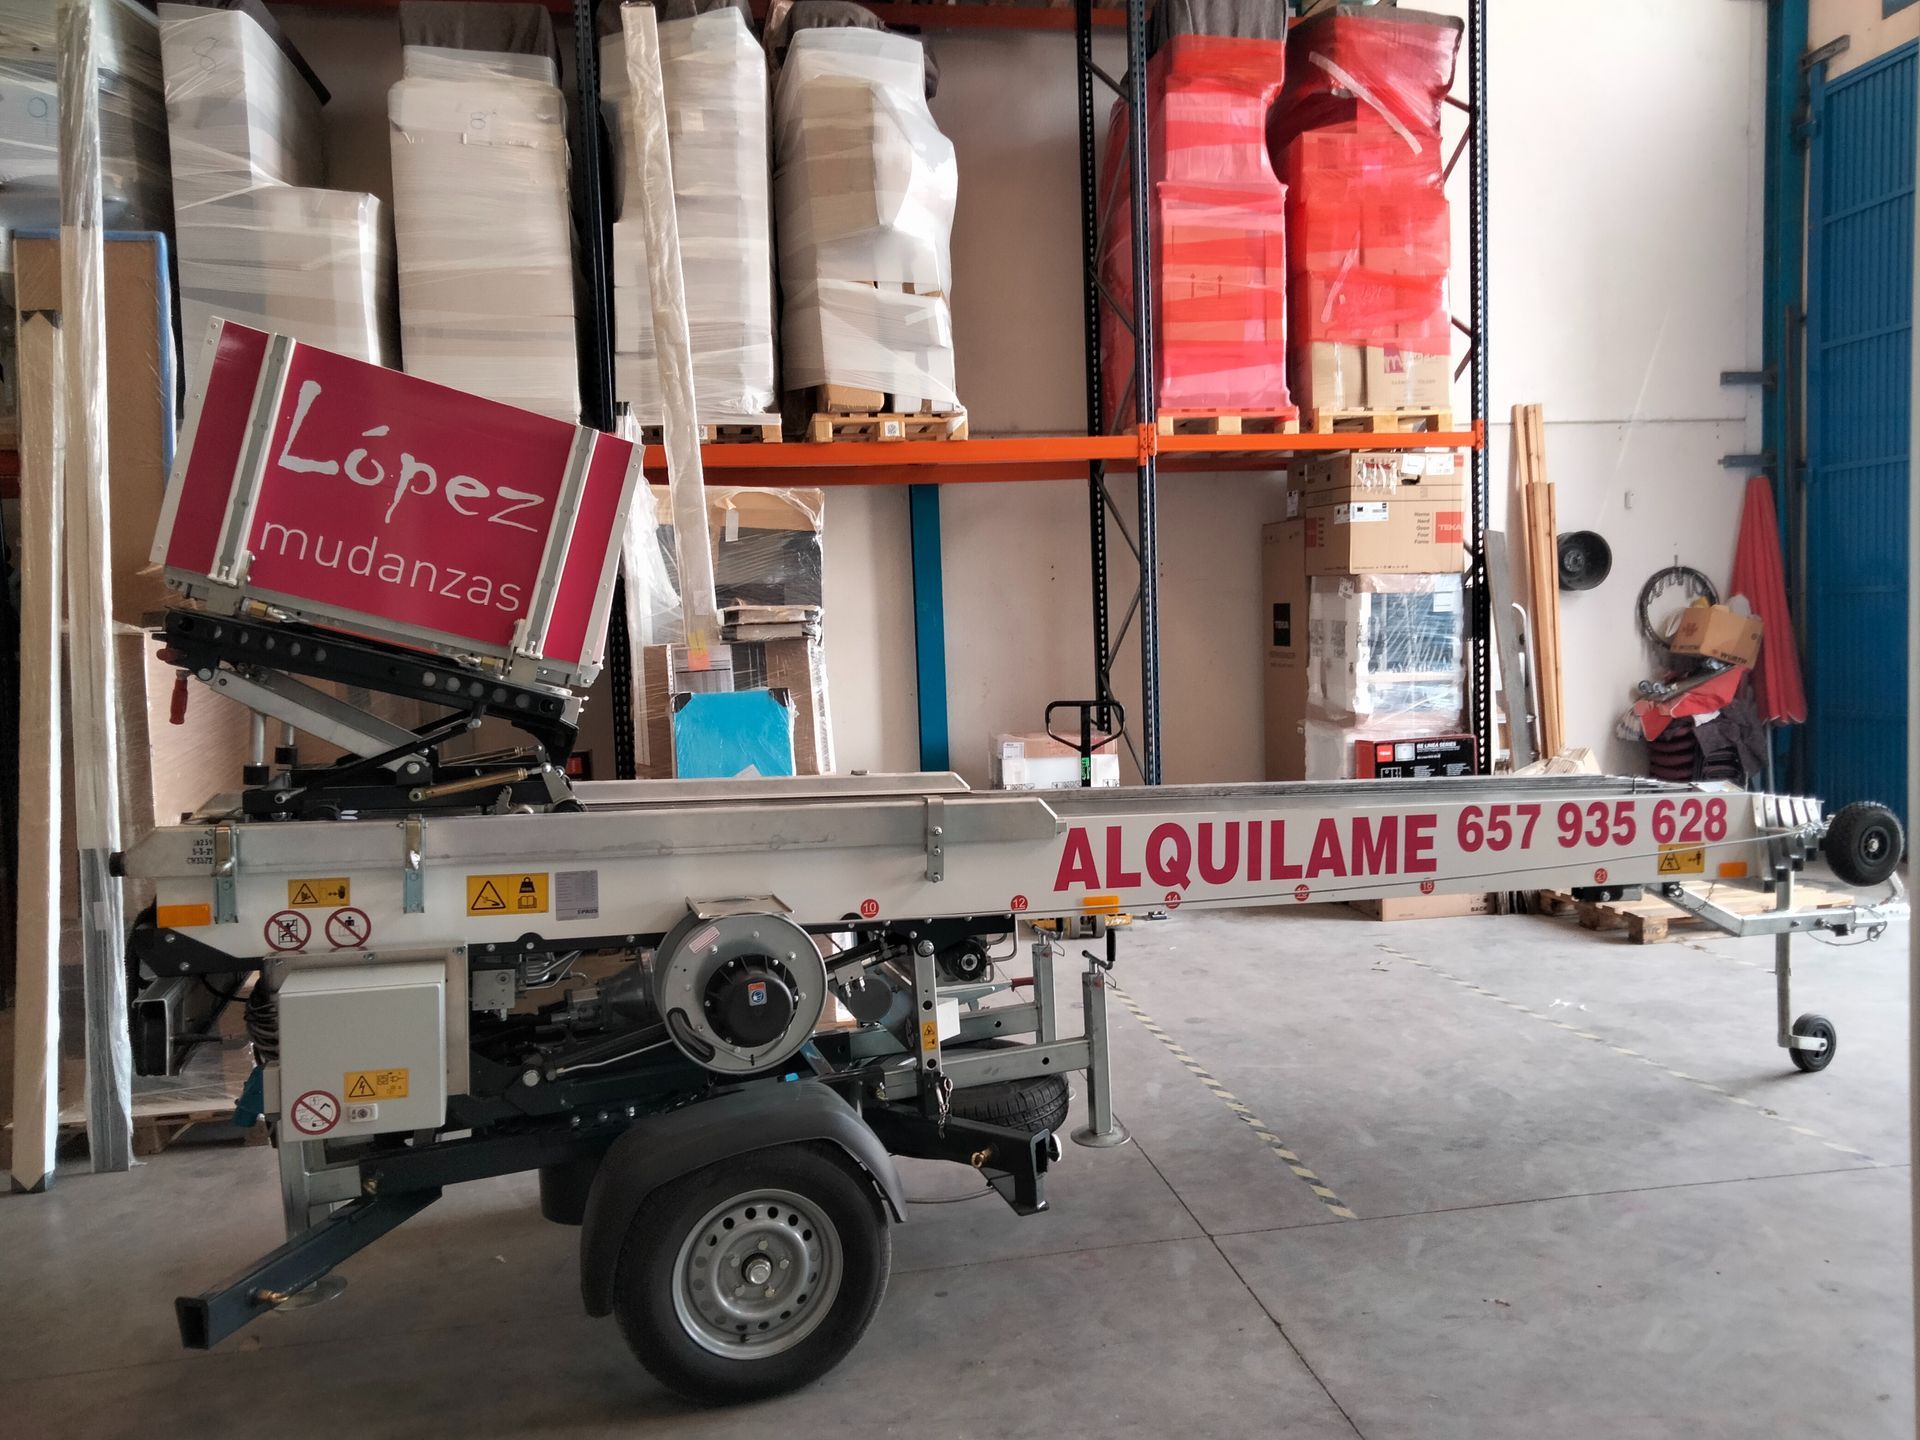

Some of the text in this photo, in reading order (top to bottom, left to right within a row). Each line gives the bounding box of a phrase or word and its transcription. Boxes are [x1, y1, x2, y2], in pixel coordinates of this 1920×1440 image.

[277, 379, 545, 534] López
[1438, 523, 1462, 531] TEKA
[259, 521, 521, 612] mudanzas
[1053, 797, 1727, 891] ALQUILAME 657 935 628
[1422, 881, 1433, 890] 18
[863, 901, 877, 912] 10
[1012, 897, 1026, 908] 12
